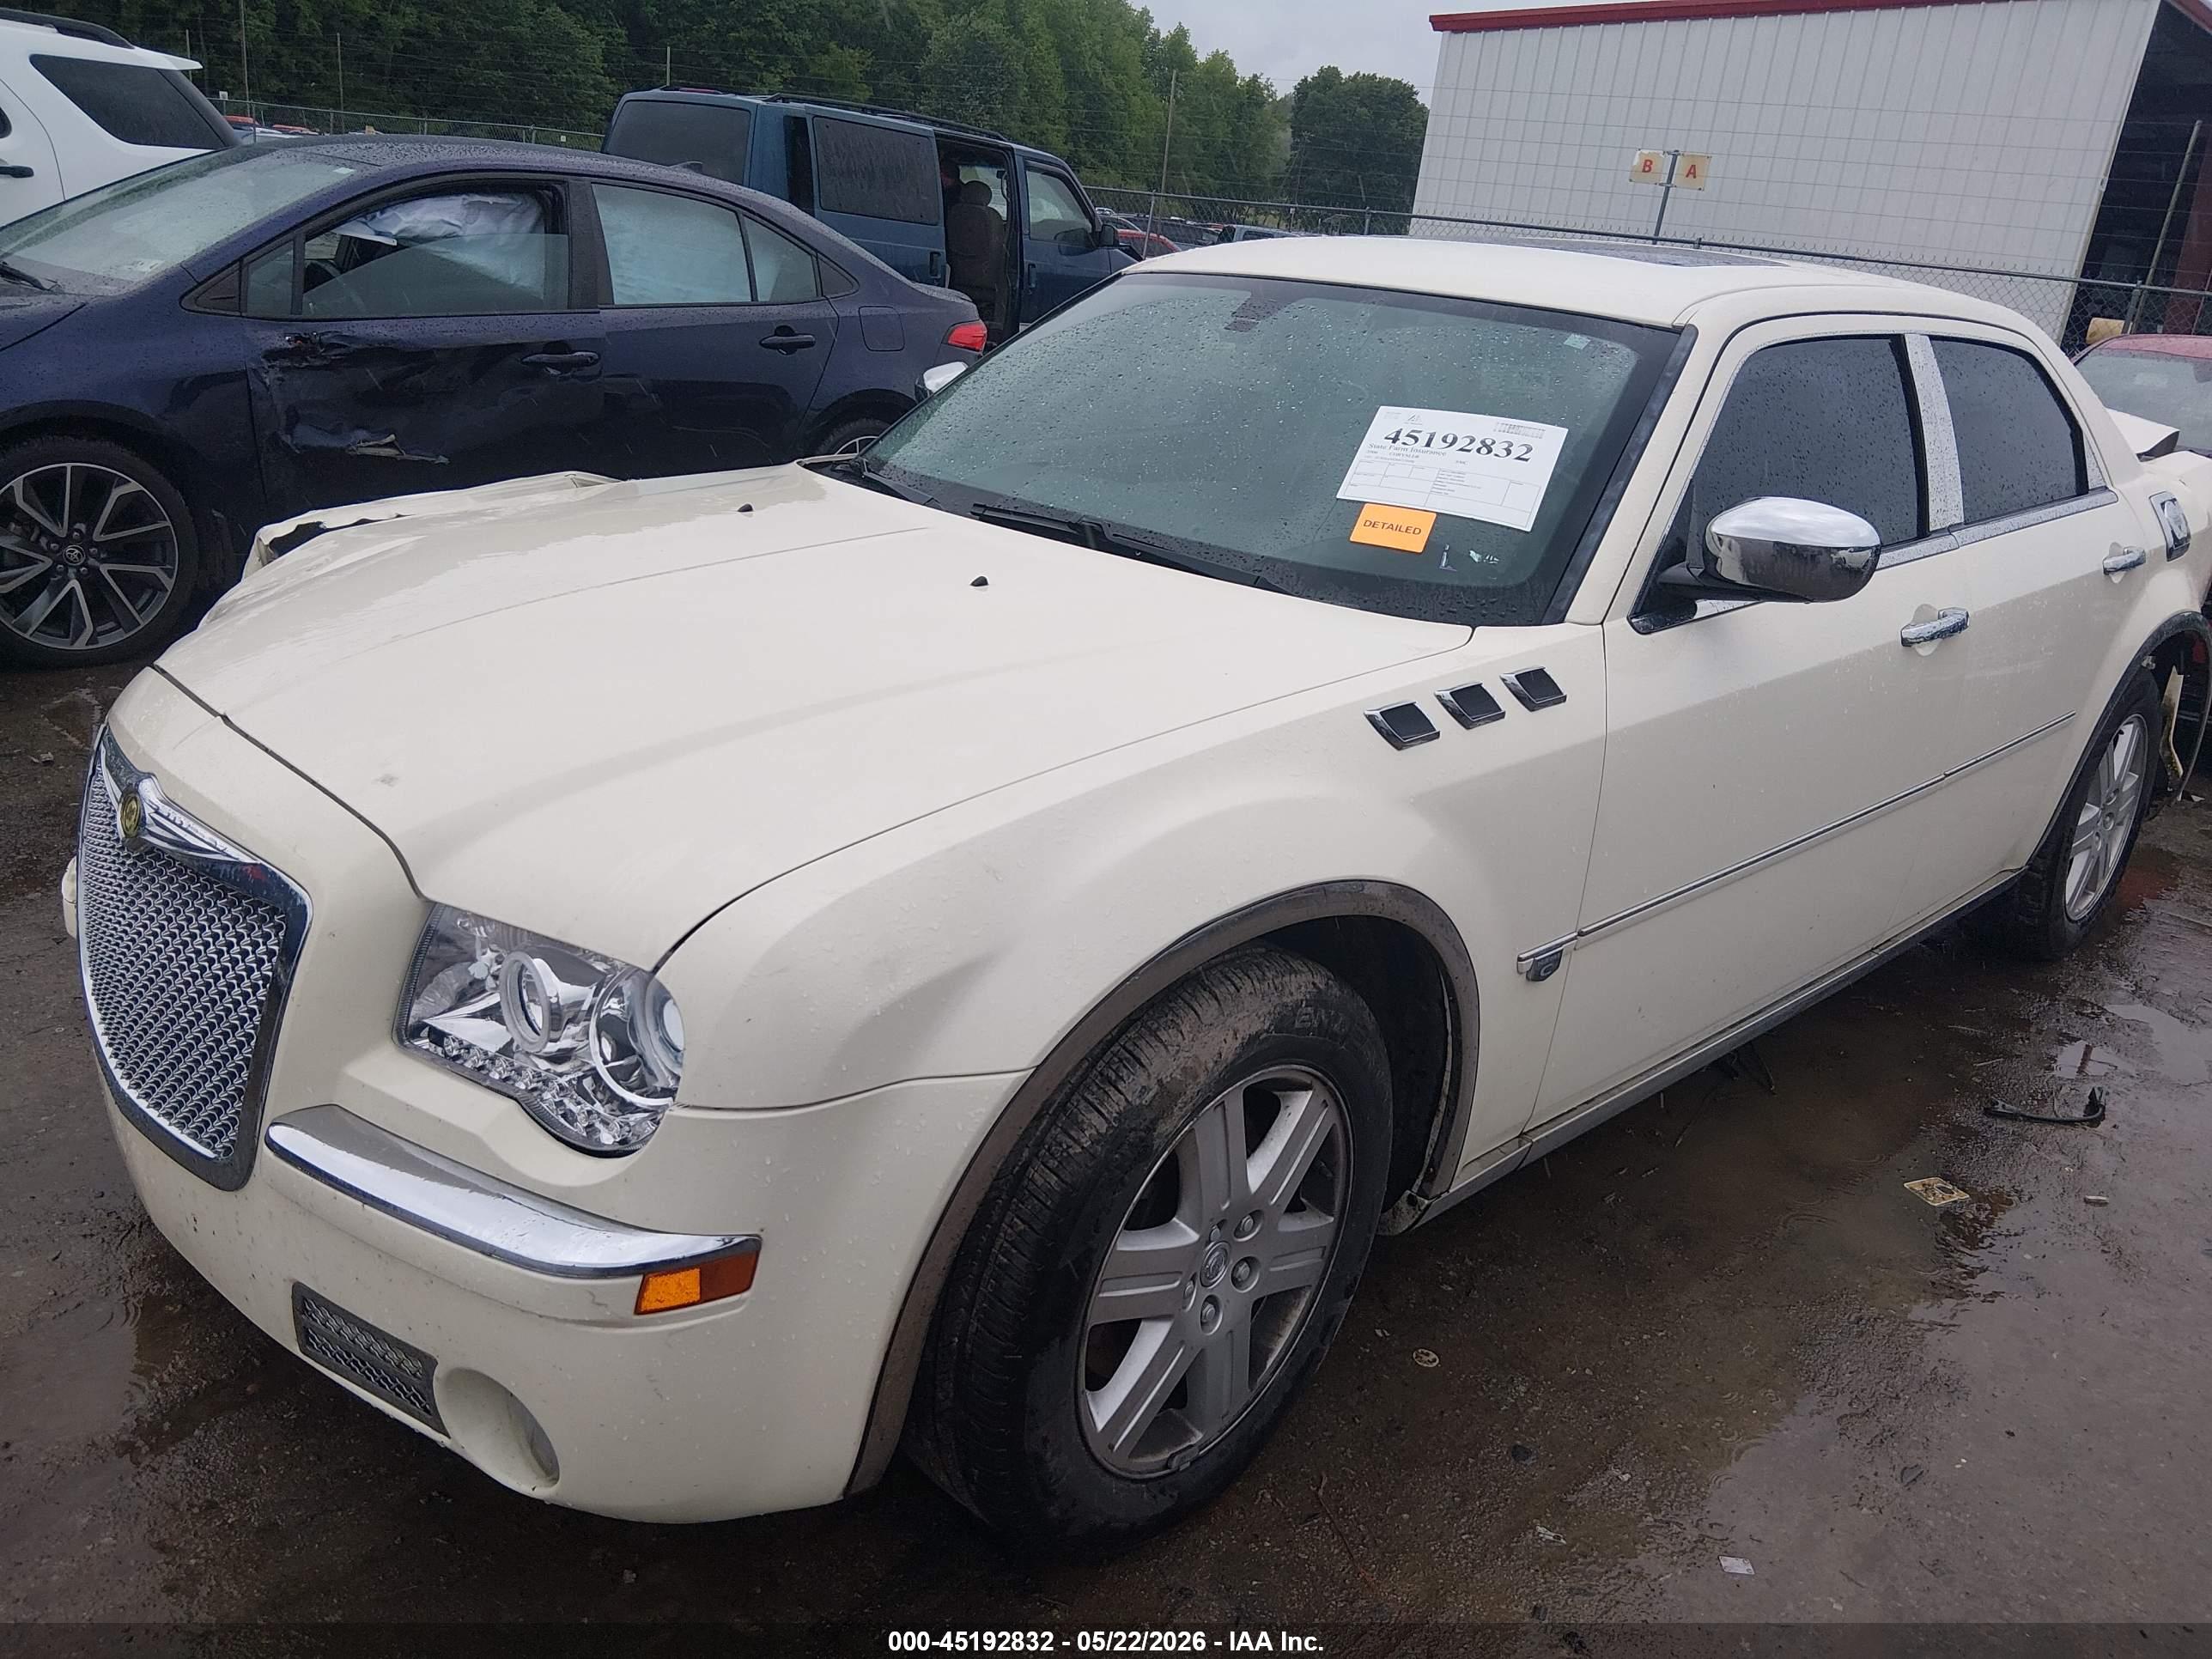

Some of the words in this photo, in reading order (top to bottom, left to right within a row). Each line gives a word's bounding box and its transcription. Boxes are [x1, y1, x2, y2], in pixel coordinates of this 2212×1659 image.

[1642, 159, 1653, 173] B
[1686, 164, 1697, 179] A
[1384, 428, 1533, 462] 45192832
[1389, 444, 1408, 453] Farm
[1409, 447, 1447, 457] Insurance
[1363, 519, 1422, 536] DETAILED
